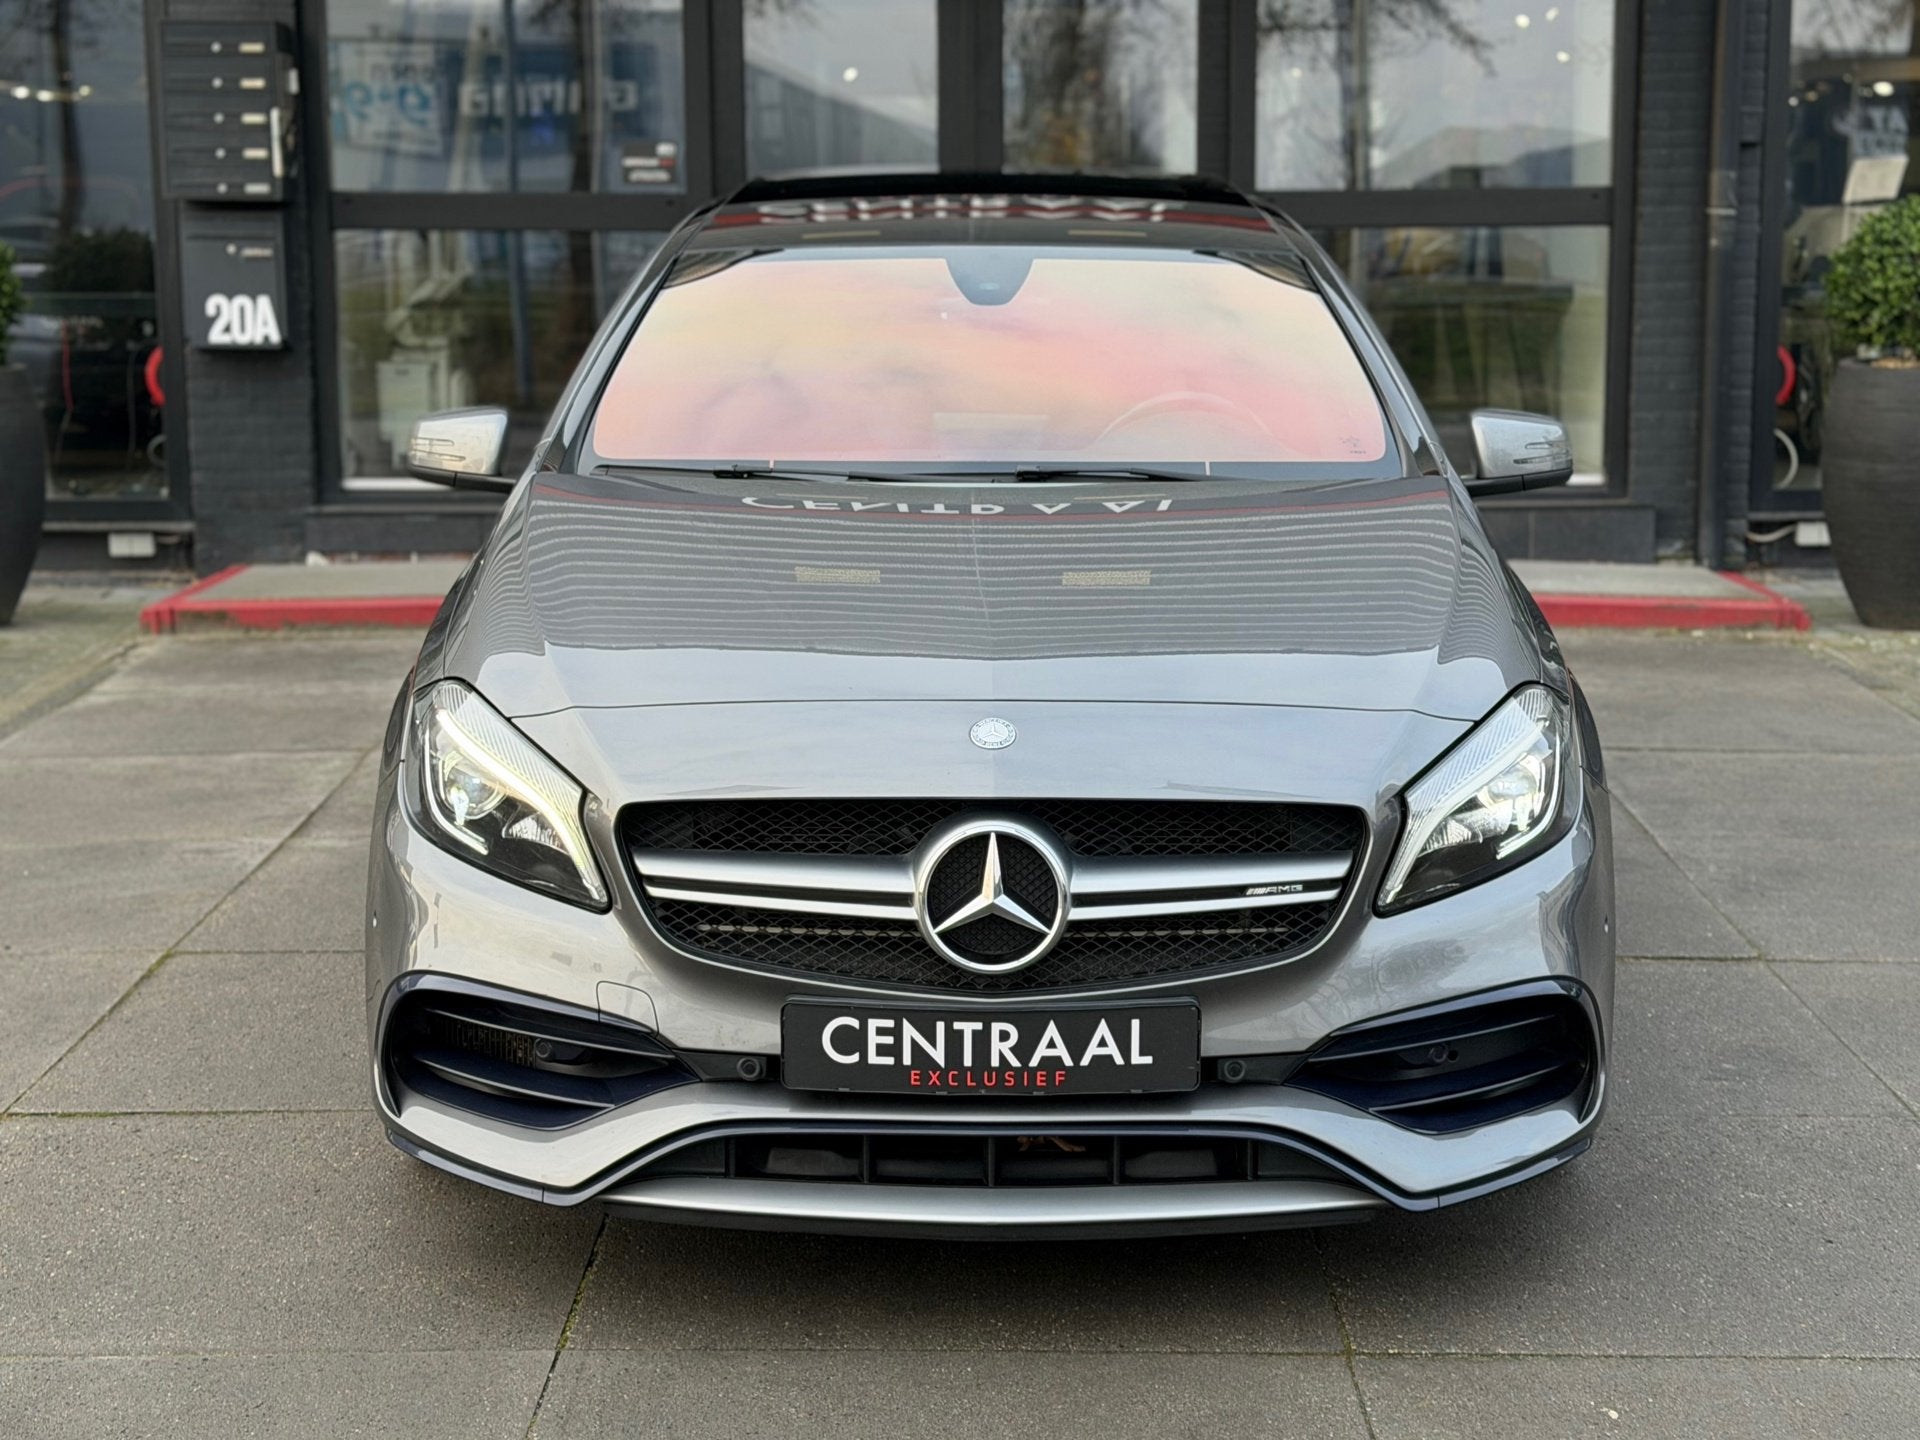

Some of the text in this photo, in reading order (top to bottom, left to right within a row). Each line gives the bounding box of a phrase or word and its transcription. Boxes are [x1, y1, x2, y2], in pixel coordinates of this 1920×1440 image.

[204, 294, 281, 344] 20A
[822, 1016, 1153, 1068] CENTRAAL
[910, 1070, 1066, 1087] EXCLUSIEF
